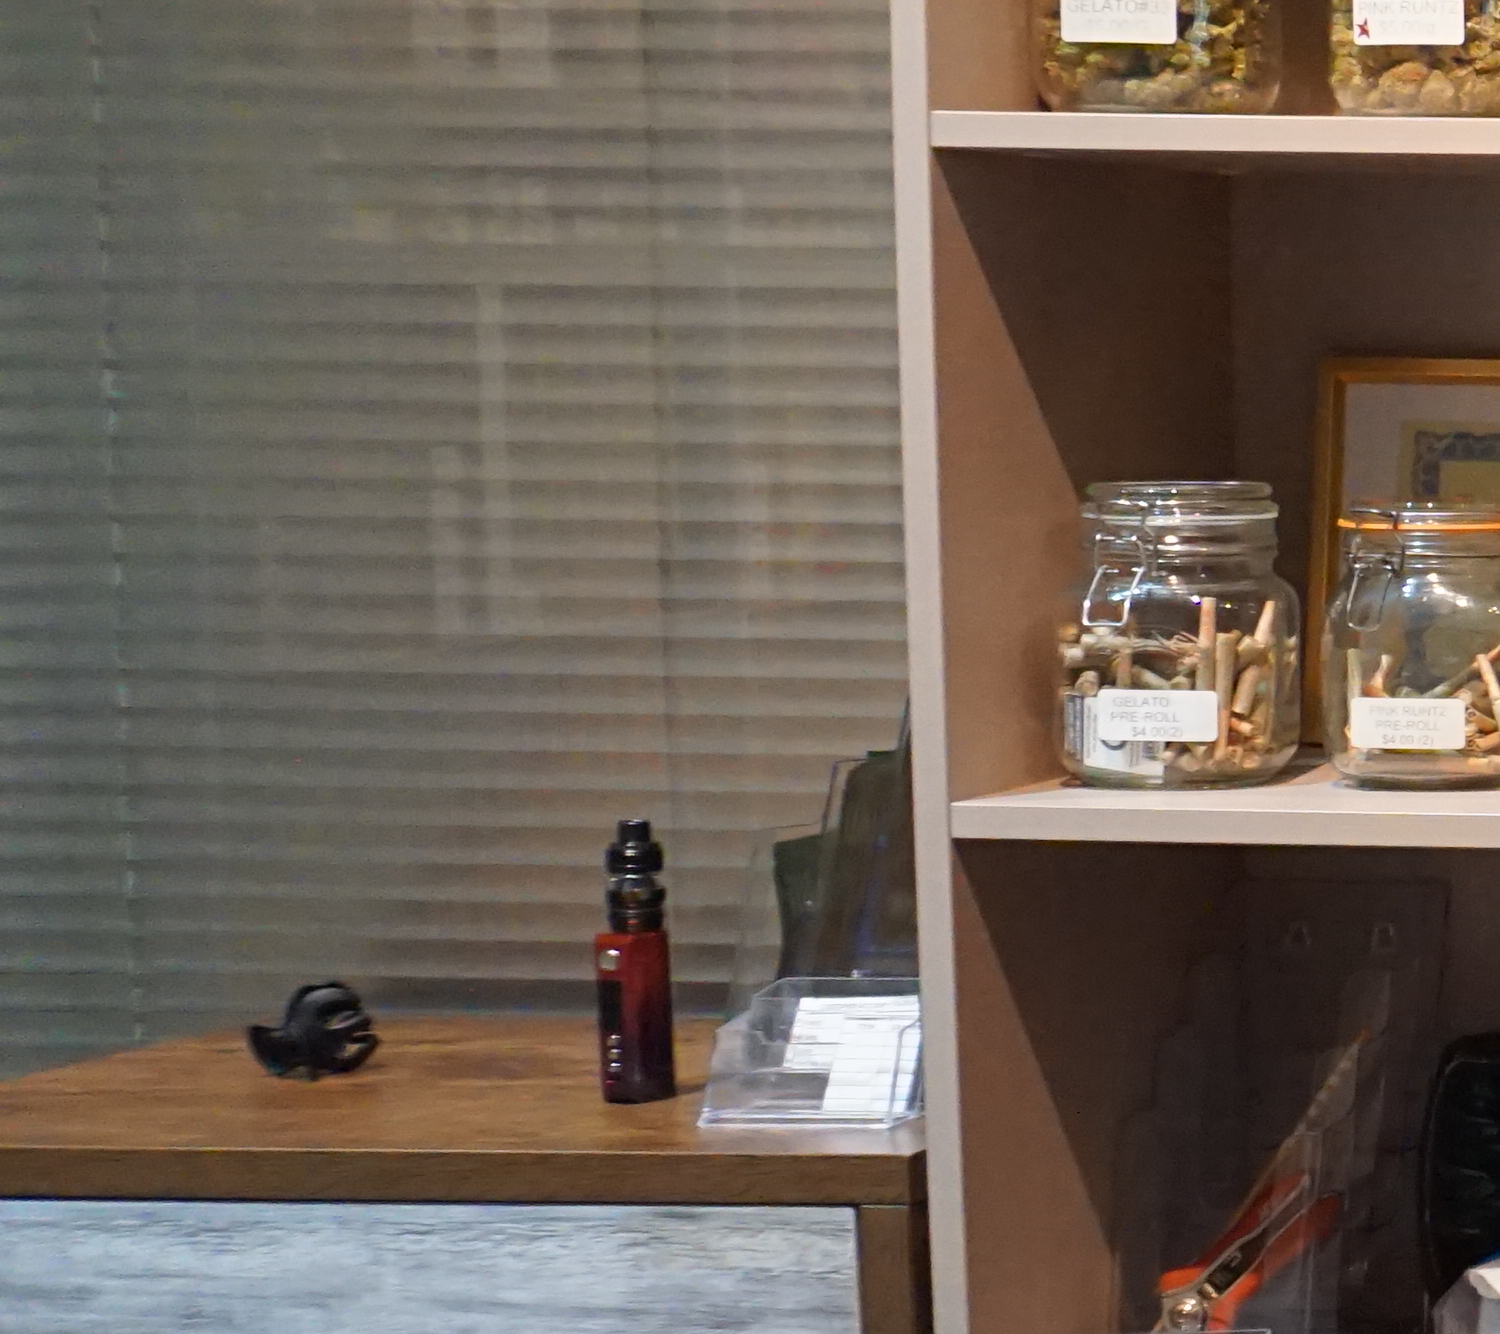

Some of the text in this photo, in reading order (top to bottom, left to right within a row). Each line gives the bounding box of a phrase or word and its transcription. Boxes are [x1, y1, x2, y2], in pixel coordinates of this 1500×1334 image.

[1359, 0, 1460, 15] PINK RUNTZ
[1112, 696, 1170, 708] GELATO
[1110, 711, 1180, 723] PRE-ROLL
[1402, 705, 1448, 717] RUNTZ
[1375, 719, 1441, 731] PRE-ROLL
[1381, 734, 1415, 746] $400
